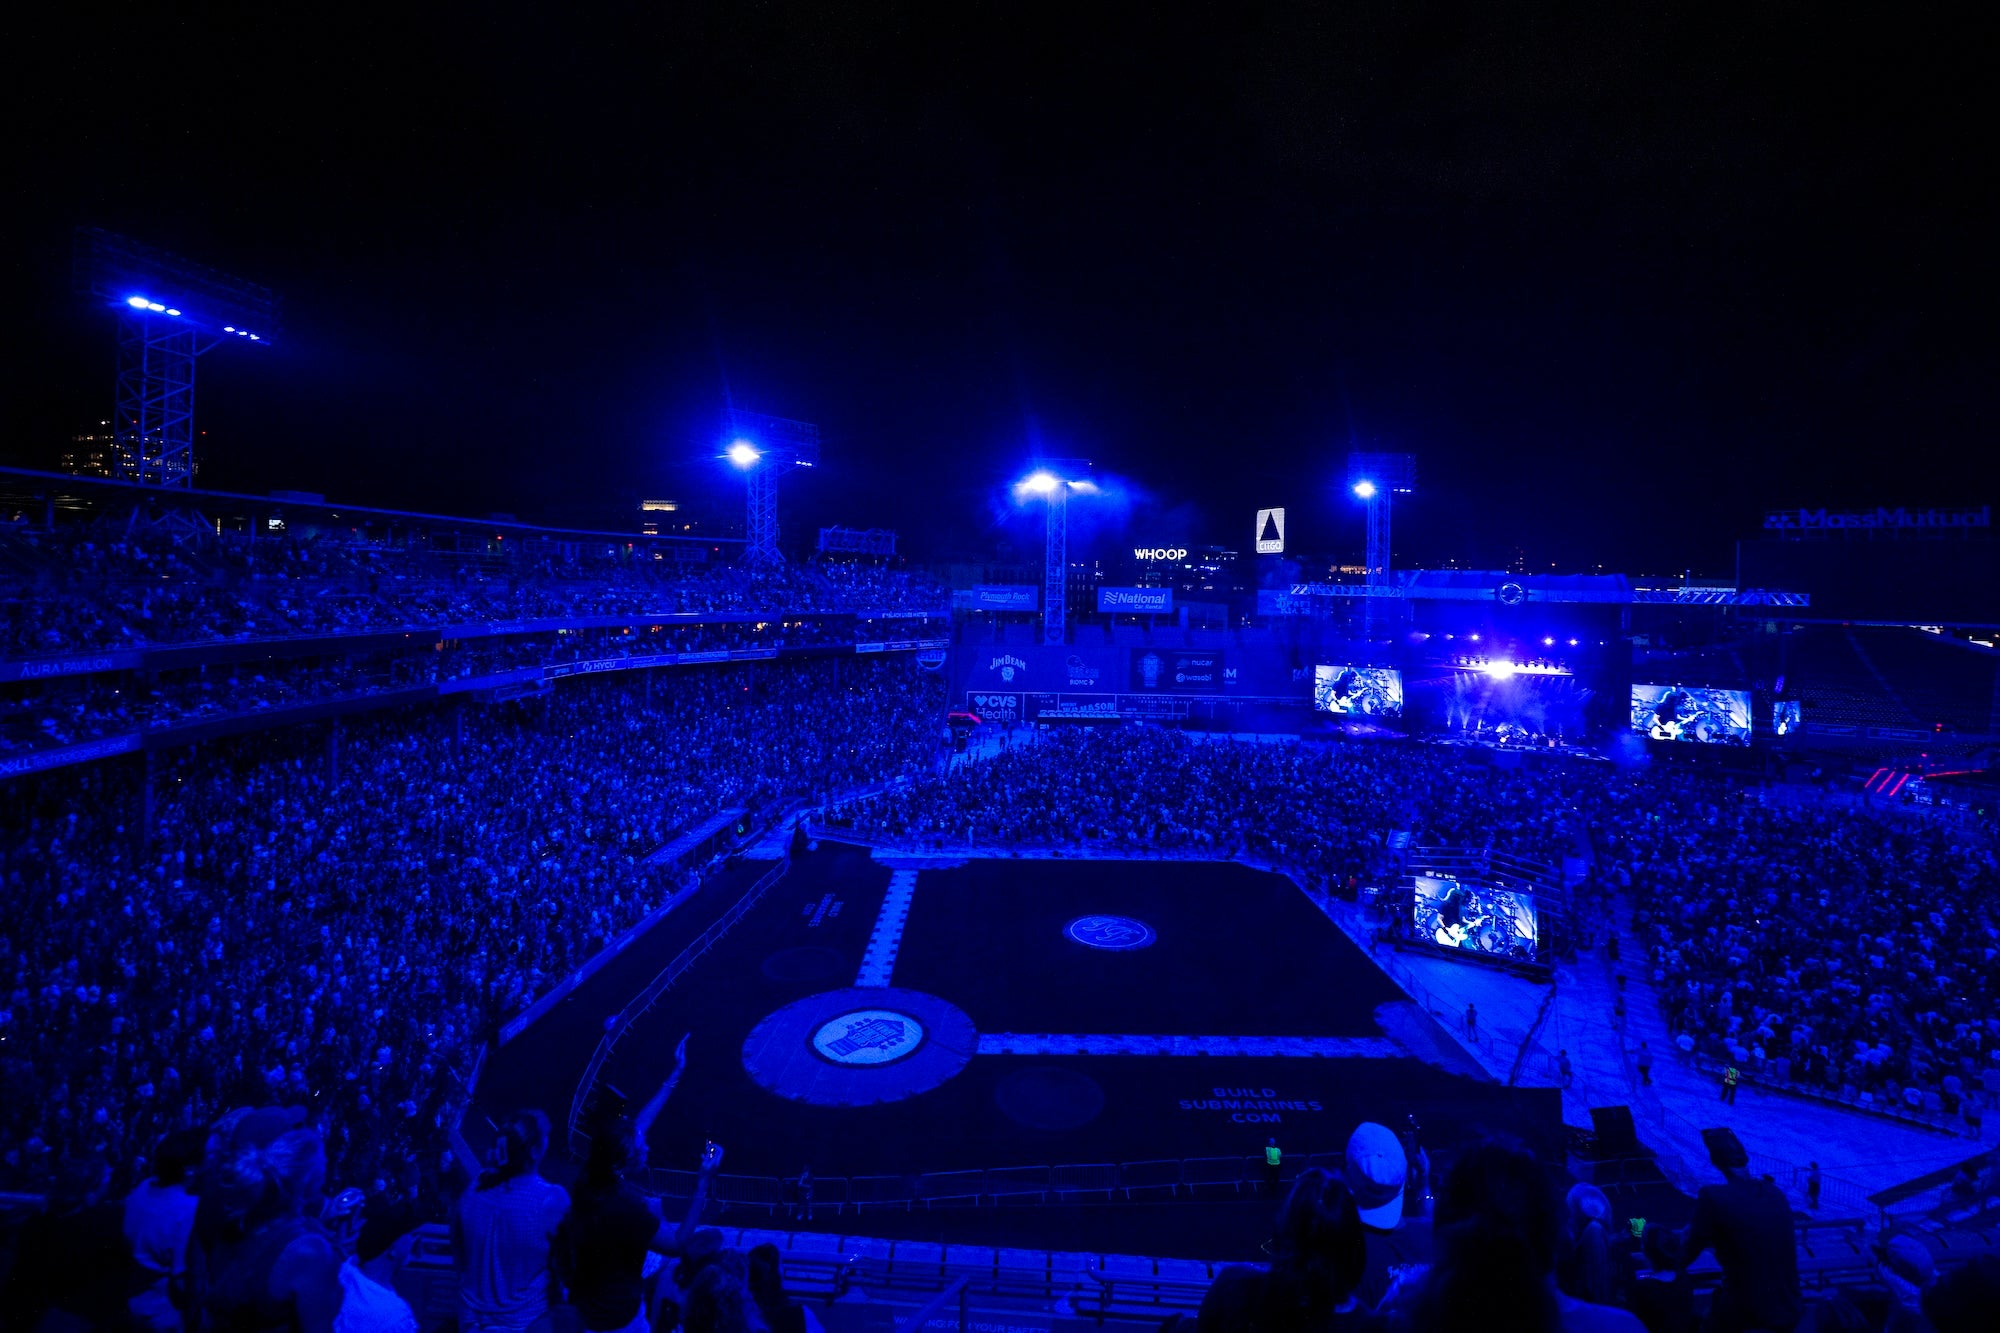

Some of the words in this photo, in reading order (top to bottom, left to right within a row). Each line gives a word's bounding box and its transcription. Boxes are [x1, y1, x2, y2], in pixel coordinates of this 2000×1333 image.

[1799, 505, 1991, 529] MassMutual
[1134, 548, 1188, 560] WHOOP
[1118, 592, 1166, 603] National
[594, 661, 616, 670] HYCU
[1185, 674, 1212, 682] wasabi
[988, 695, 1017, 708] CVS
[975, 707, 1016, 720] Health
[1213, 1088, 1276, 1097] BUILD
[1179, 1100, 1323, 1111] SUBMARINES
